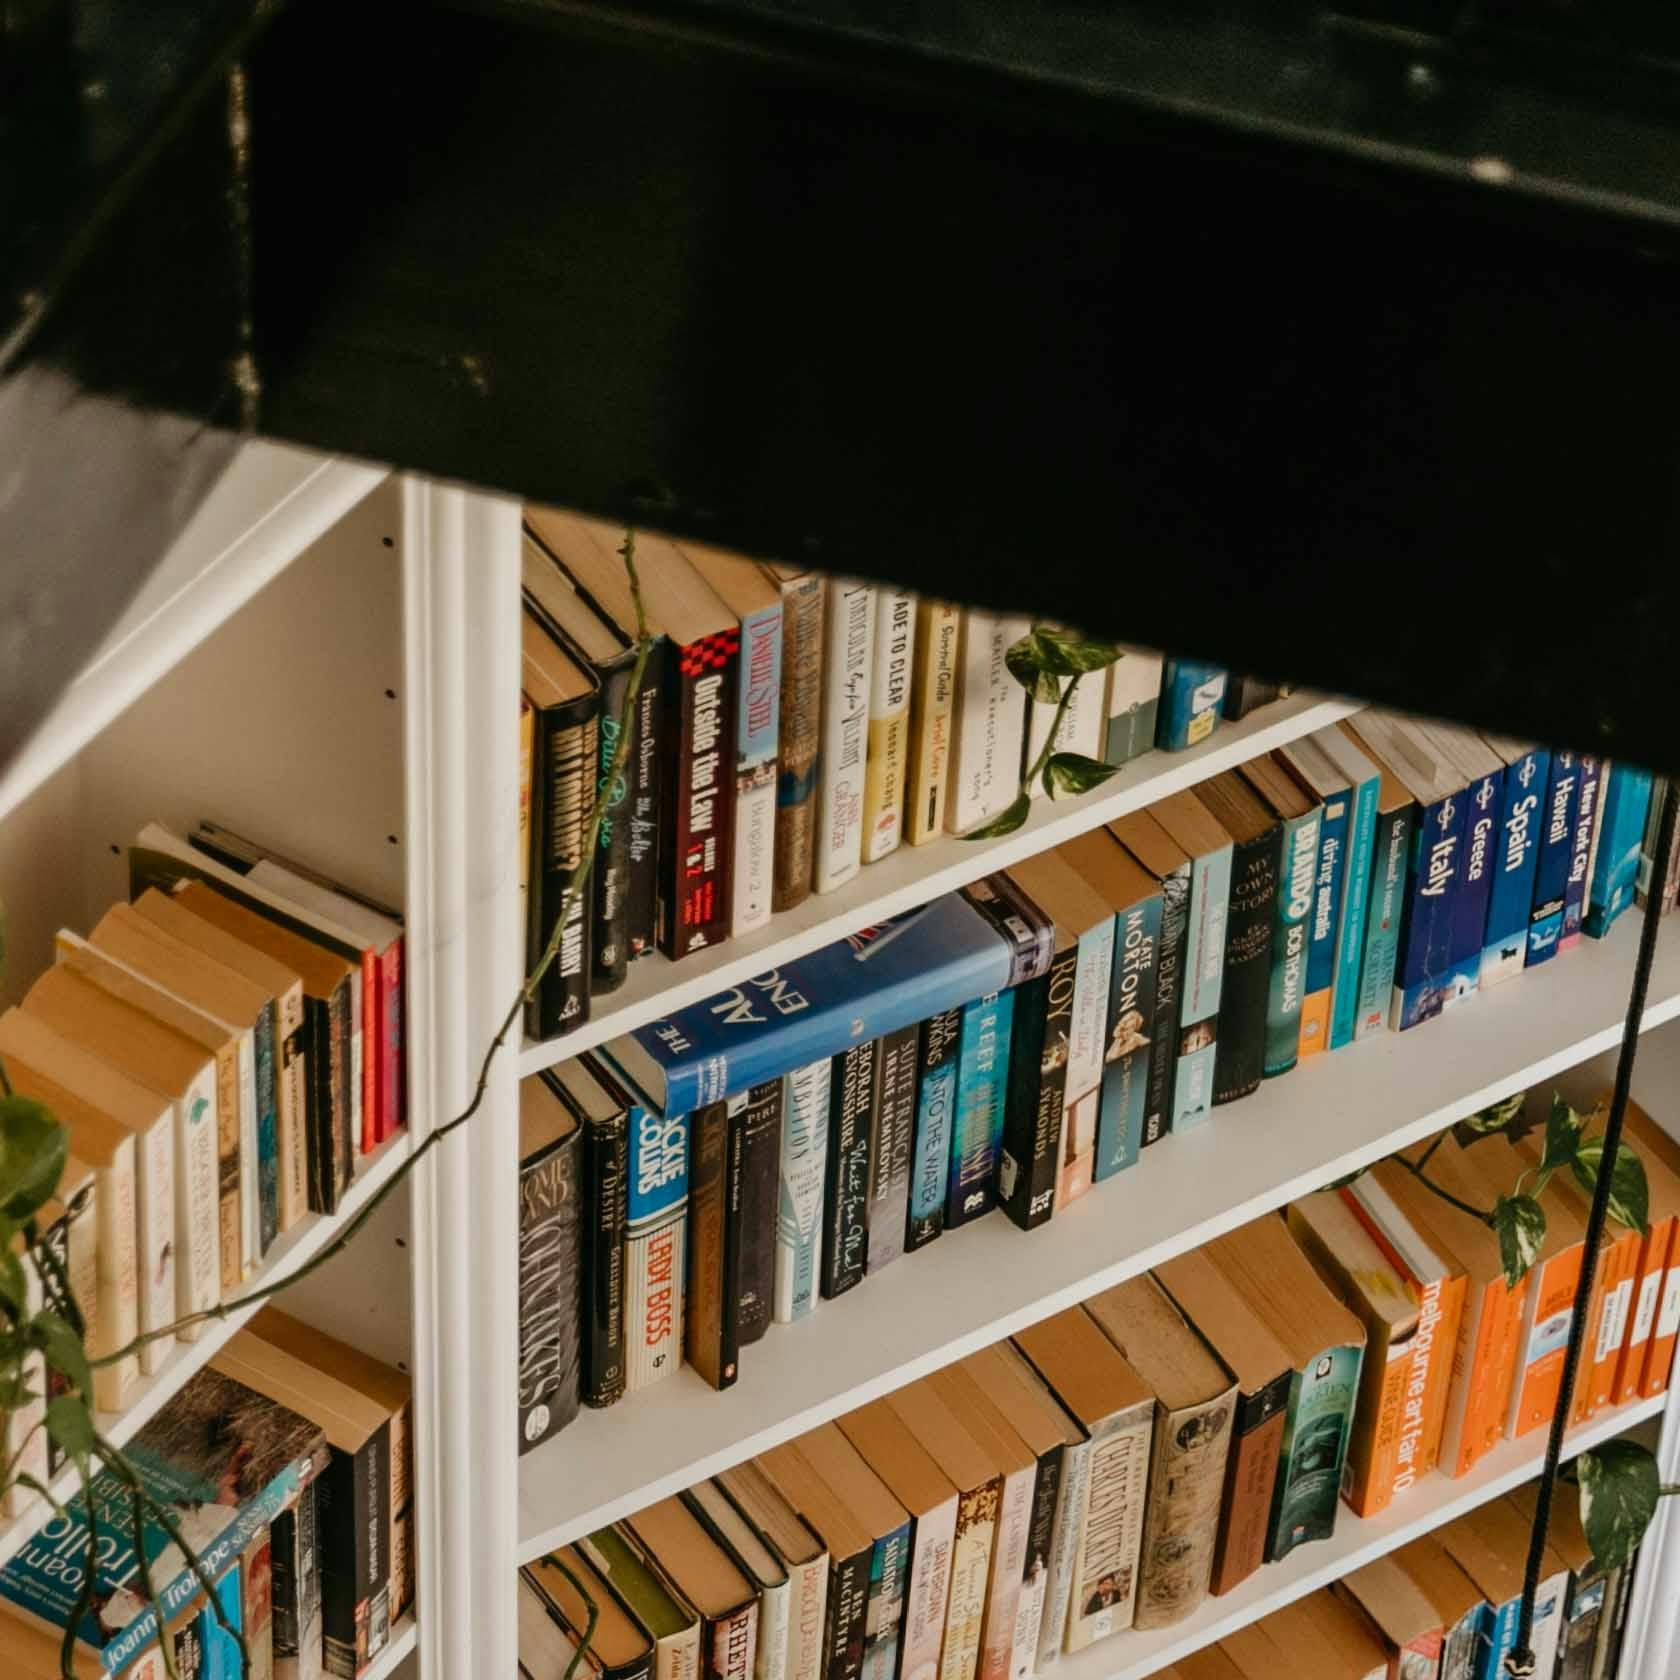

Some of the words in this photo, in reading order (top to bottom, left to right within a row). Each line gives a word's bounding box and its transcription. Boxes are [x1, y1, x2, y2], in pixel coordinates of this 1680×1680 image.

[890, 635, 906, 654] TO
[886, 659, 905, 707] CLEAR
[692, 674, 723, 753] Outside
[639, 739, 655, 789] Osborne
[691, 753, 719, 784] the
[689, 788, 718, 833] Law
[1549, 776, 1574, 844] Hawaii
[1579, 780, 1596, 816] New
[1468, 818, 1492, 882] Greece
[1504, 794, 1538, 872] Spain
[1575, 816, 1593, 851] York
[1288, 820, 1317, 919] BRANDO
[1317, 838, 1339, 884] diving
[1421, 836, 1458, 896] Italy
[1570, 852, 1588, 883] City
[1118, 911, 1145, 1013] MORTON
[1138, 936, 1154, 970] KATE
[1286, 924, 1303, 958] BOB
[1047, 955, 1077, 1022] ROY
[1156, 959, 1178, 1010] BLACK
[1281, 958, 1300, 1013] THOMAS
[656, 1022, 693, 1055] THE
[898, 1039, 916, 1093] SUITE
[925, 1121, 943, 1151] THE
[1033, 1086, 1051, 1160] SYMONDS
[637, 1113, 664, 1194] COLLINS
[601, 1178, 618, 1232] DESIRE
[920, 1157, 939, 1209] WATER
[648, 1232, 673, 1289] LADY
[645, 1290, 671, 1346] BOSS
[1406, 1280, 1444, 1398] melbourne
[1401, 1399, 1423, 1431] art
[1396, 1431, 1419, 1463] fair
[1089, 1436, 1134, 1513] CHARLES
[1392, 1468, 1417, 1496] 10
[934, 1543, 949, 1570] DAN
[1082, 1504, 1129, 1585] DICKENS
[834, 1566, 854, 1656] MACINTYRE
[851, 1593, 864, 1621] BEN
[927, 1570, 945, 1624] BROWN
[844, 1664, 856, 1673] A
